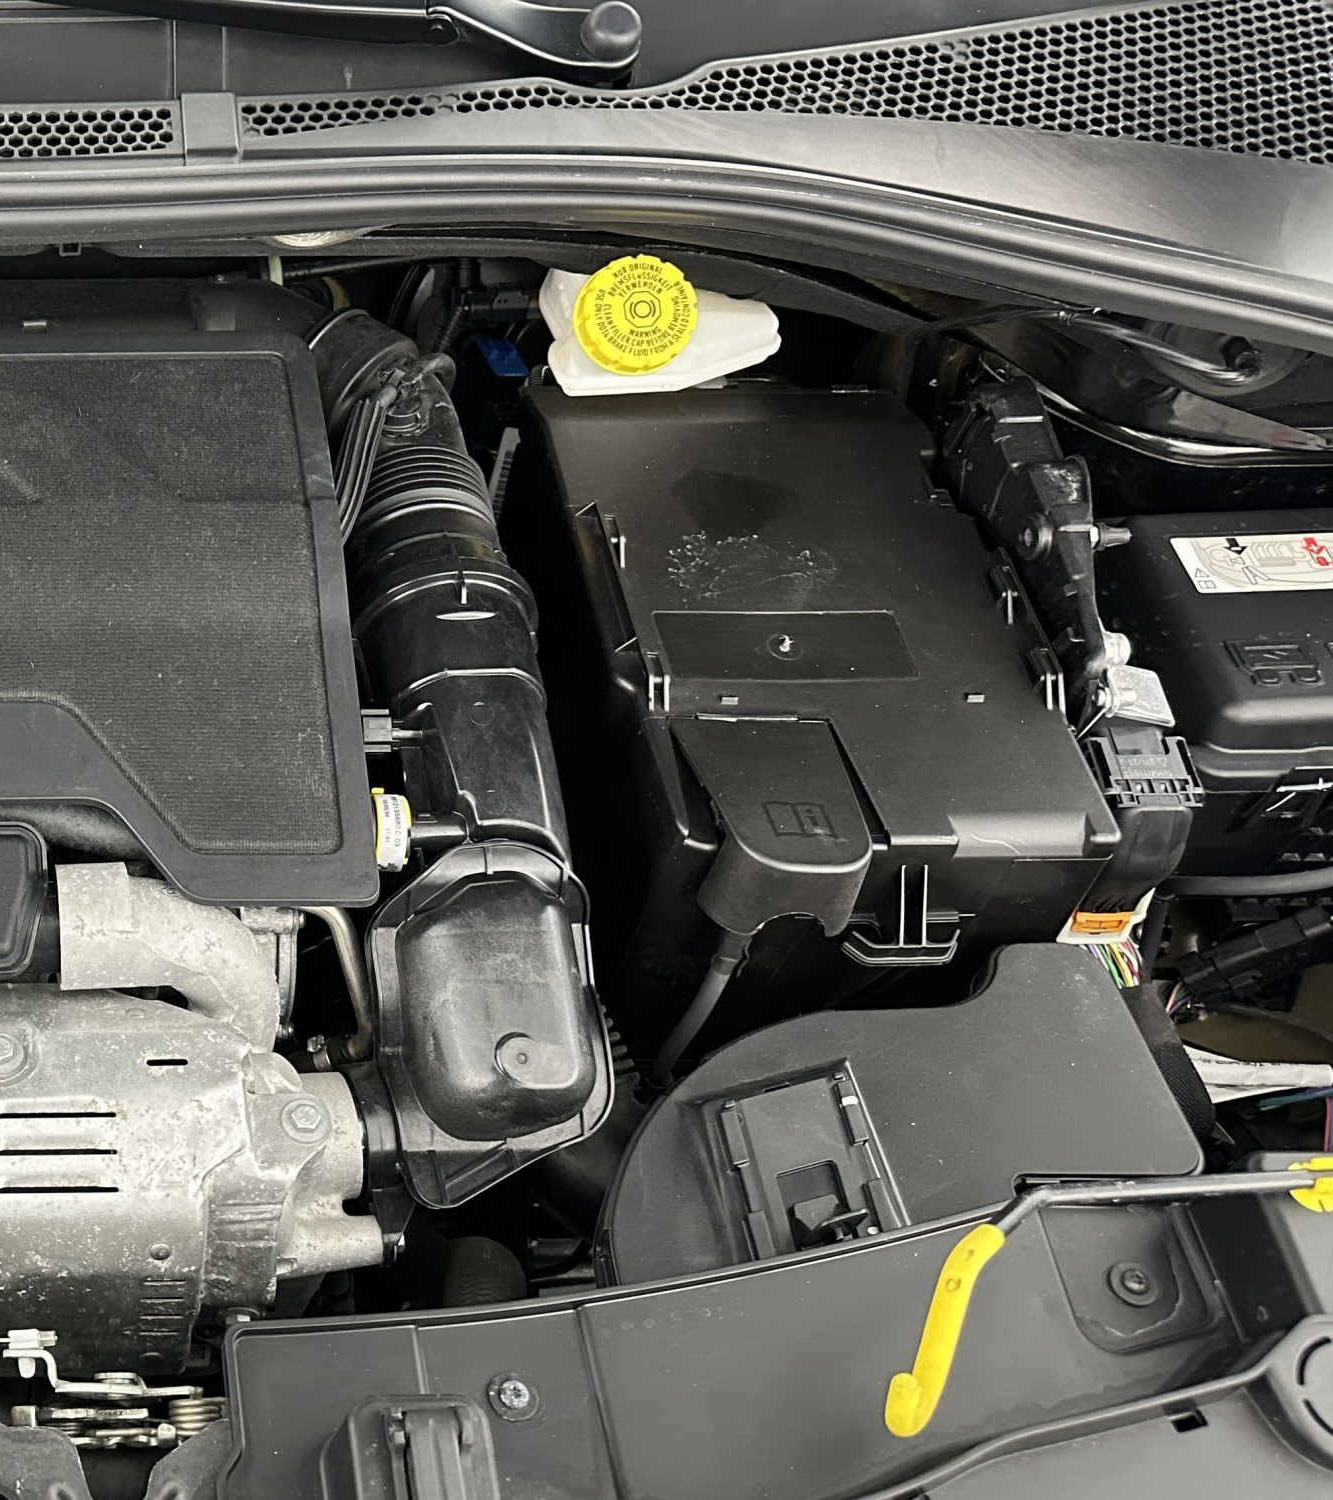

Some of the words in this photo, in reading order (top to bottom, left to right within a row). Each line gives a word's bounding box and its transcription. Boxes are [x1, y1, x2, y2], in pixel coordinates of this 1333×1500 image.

[612, 266, 628, 278] NUR
[628, 263, 663, 275] ORIGINAL
[595, 289, 606, 302] USE
[617, 280, 663, 297] VERWENDEN
[672, 280, 691, 318] CONTAINER
[594, 303, 604, 320] ONLY
[603, 303, 614, 326] CLEAN
[609, 324, 631, 344] FILLER
[631, 339, 645, 347] CAP
[646, 330, 672, 347] BEFORE
[667, 295, 681, 332] REMOVING
[628, 326, 662, 338] WARNING
[671, 318, 690, 343] SEALED
[607, 335, 629, 353] BRAKE
[649, 342, 669, 355] FROM
[667, 339, 675, 347] A
[628, 347, 649, 357] FLUID
